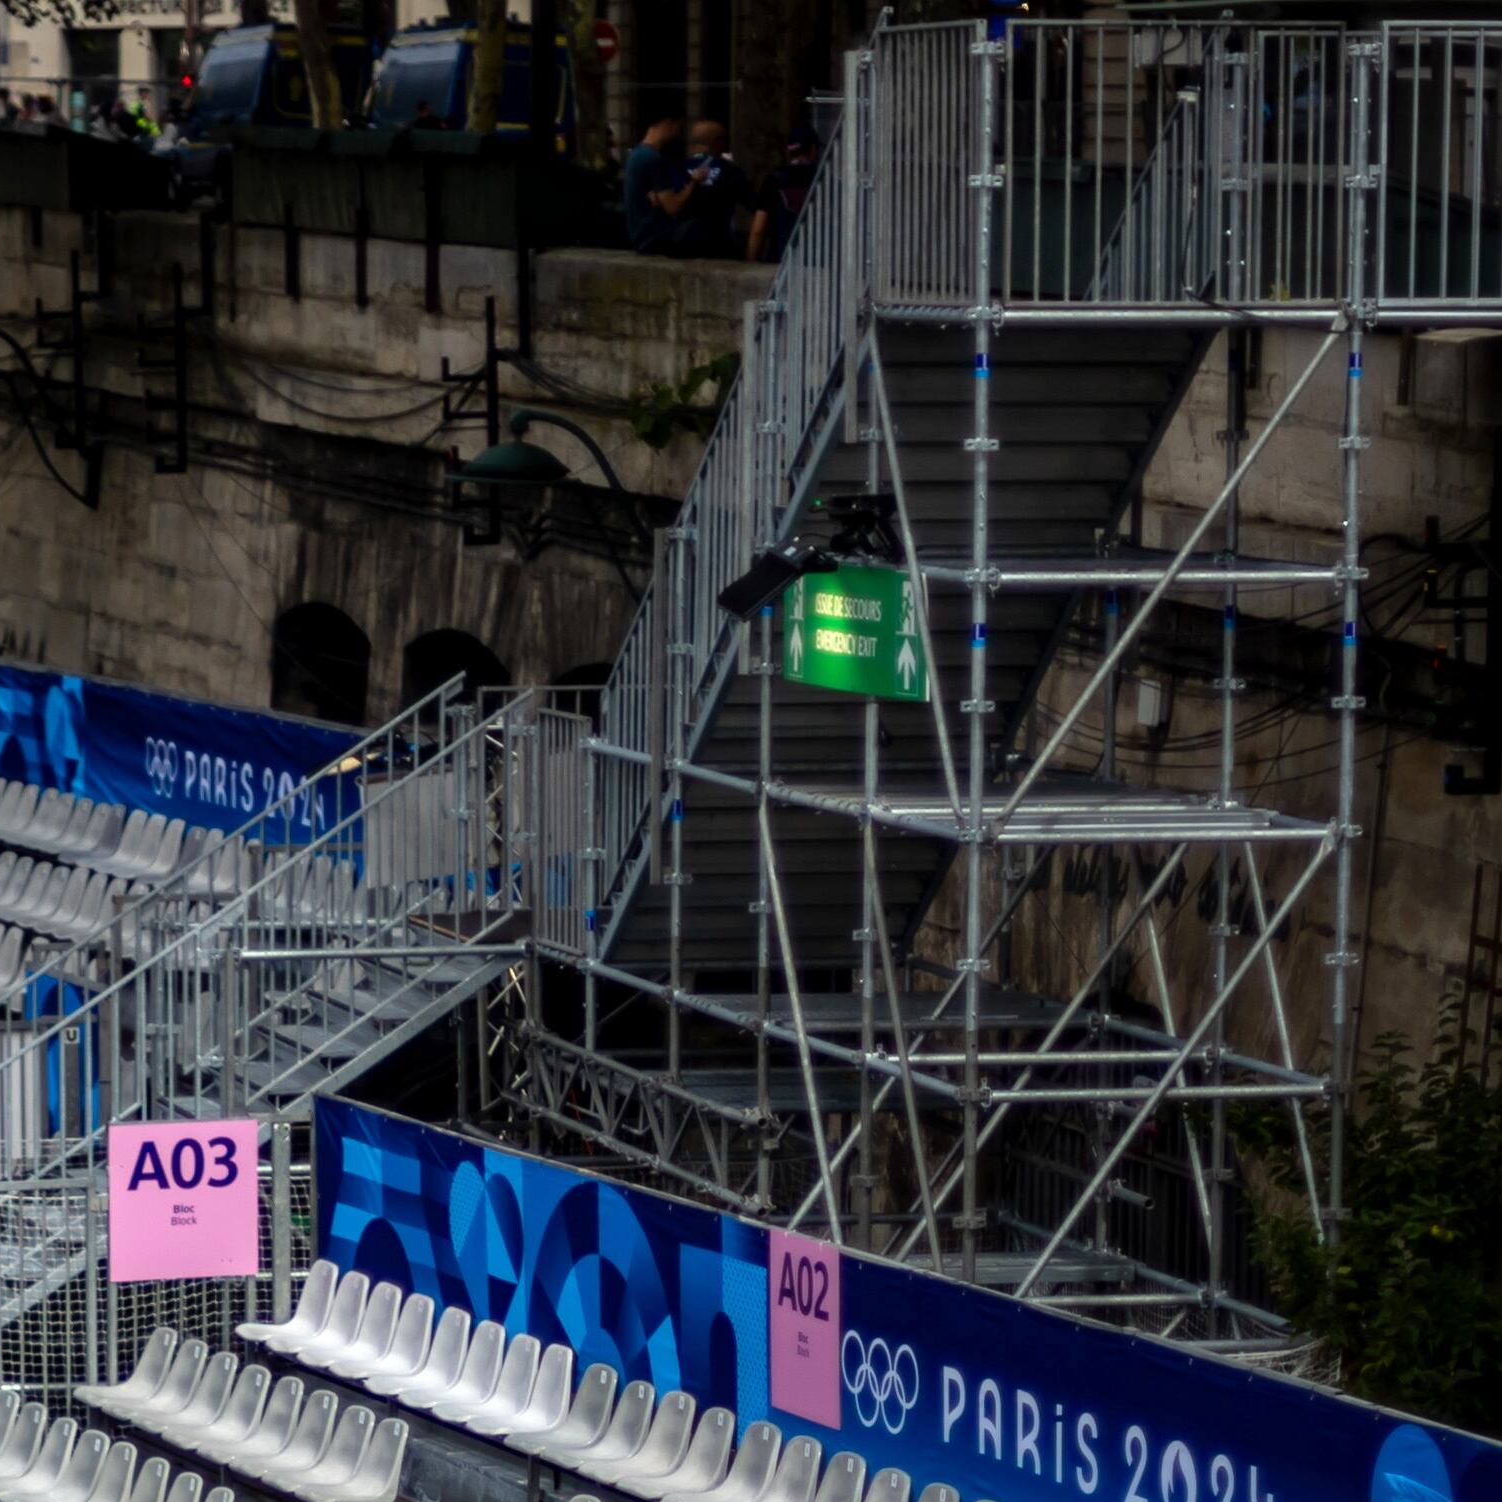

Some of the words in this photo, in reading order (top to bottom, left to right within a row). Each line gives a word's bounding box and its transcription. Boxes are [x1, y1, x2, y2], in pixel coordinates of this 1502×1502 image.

[844, 597, 882, 622] SECOURS
[816, 628, 856, 655] EMERGENCY
[858, 636, 877, 657] EXIT
[127, 1136, 239, 1191] A03
[170, 1216, 197, 1226] Block
[173, 1204, 195, 1214] Bloc
[778, 1251, 829, 1322] A02
